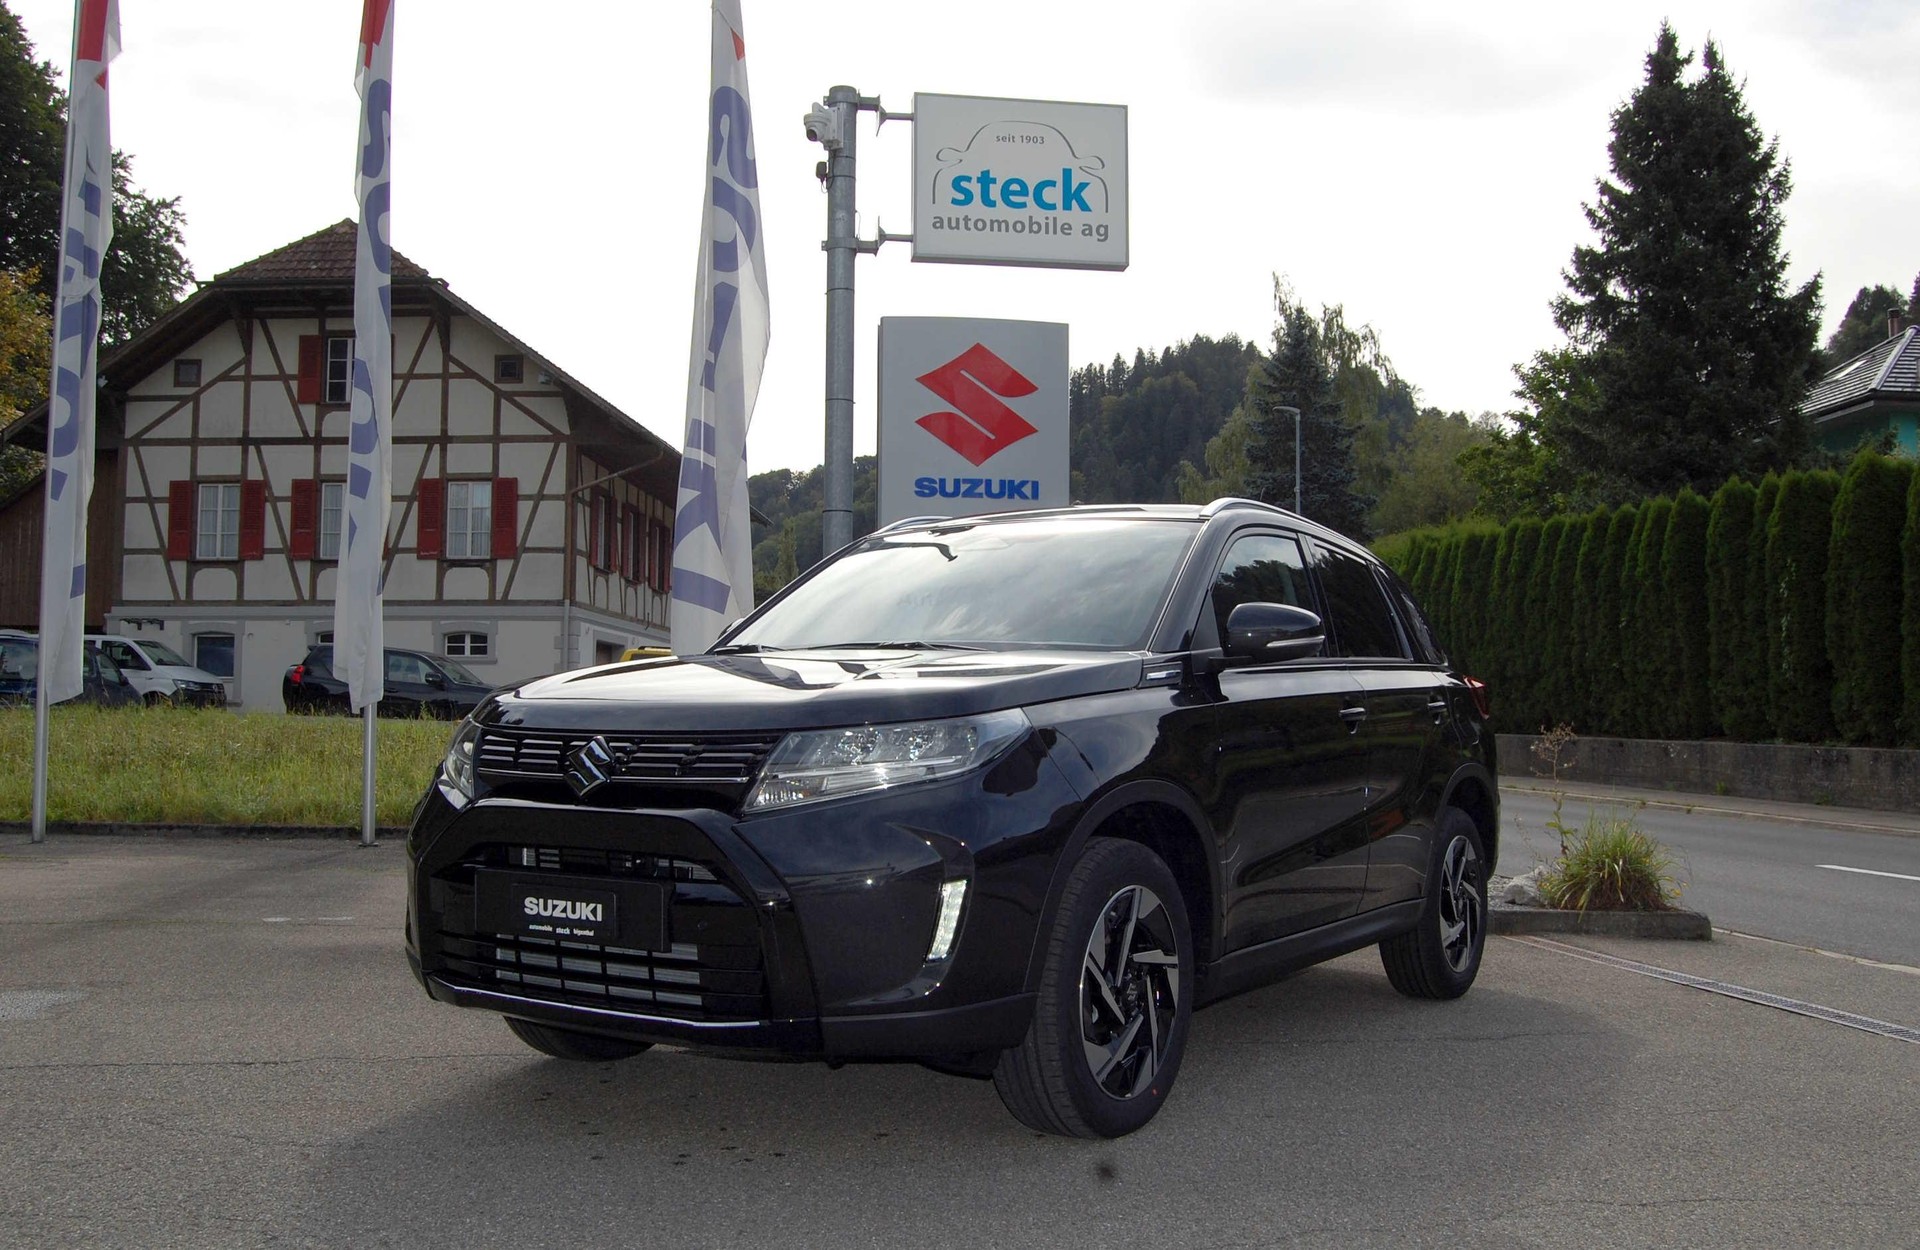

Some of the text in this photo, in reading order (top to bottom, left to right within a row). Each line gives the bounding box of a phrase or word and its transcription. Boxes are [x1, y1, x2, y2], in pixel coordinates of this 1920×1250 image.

[995, 133, 1046, 145] seit 1903
[951, 168, 1092, 212] steck
[932, 214, 1109, 243] automobile ag
[914, 477, 1040, 501] SUZUKI
[524, 896, 602, 921] SUZUKI
